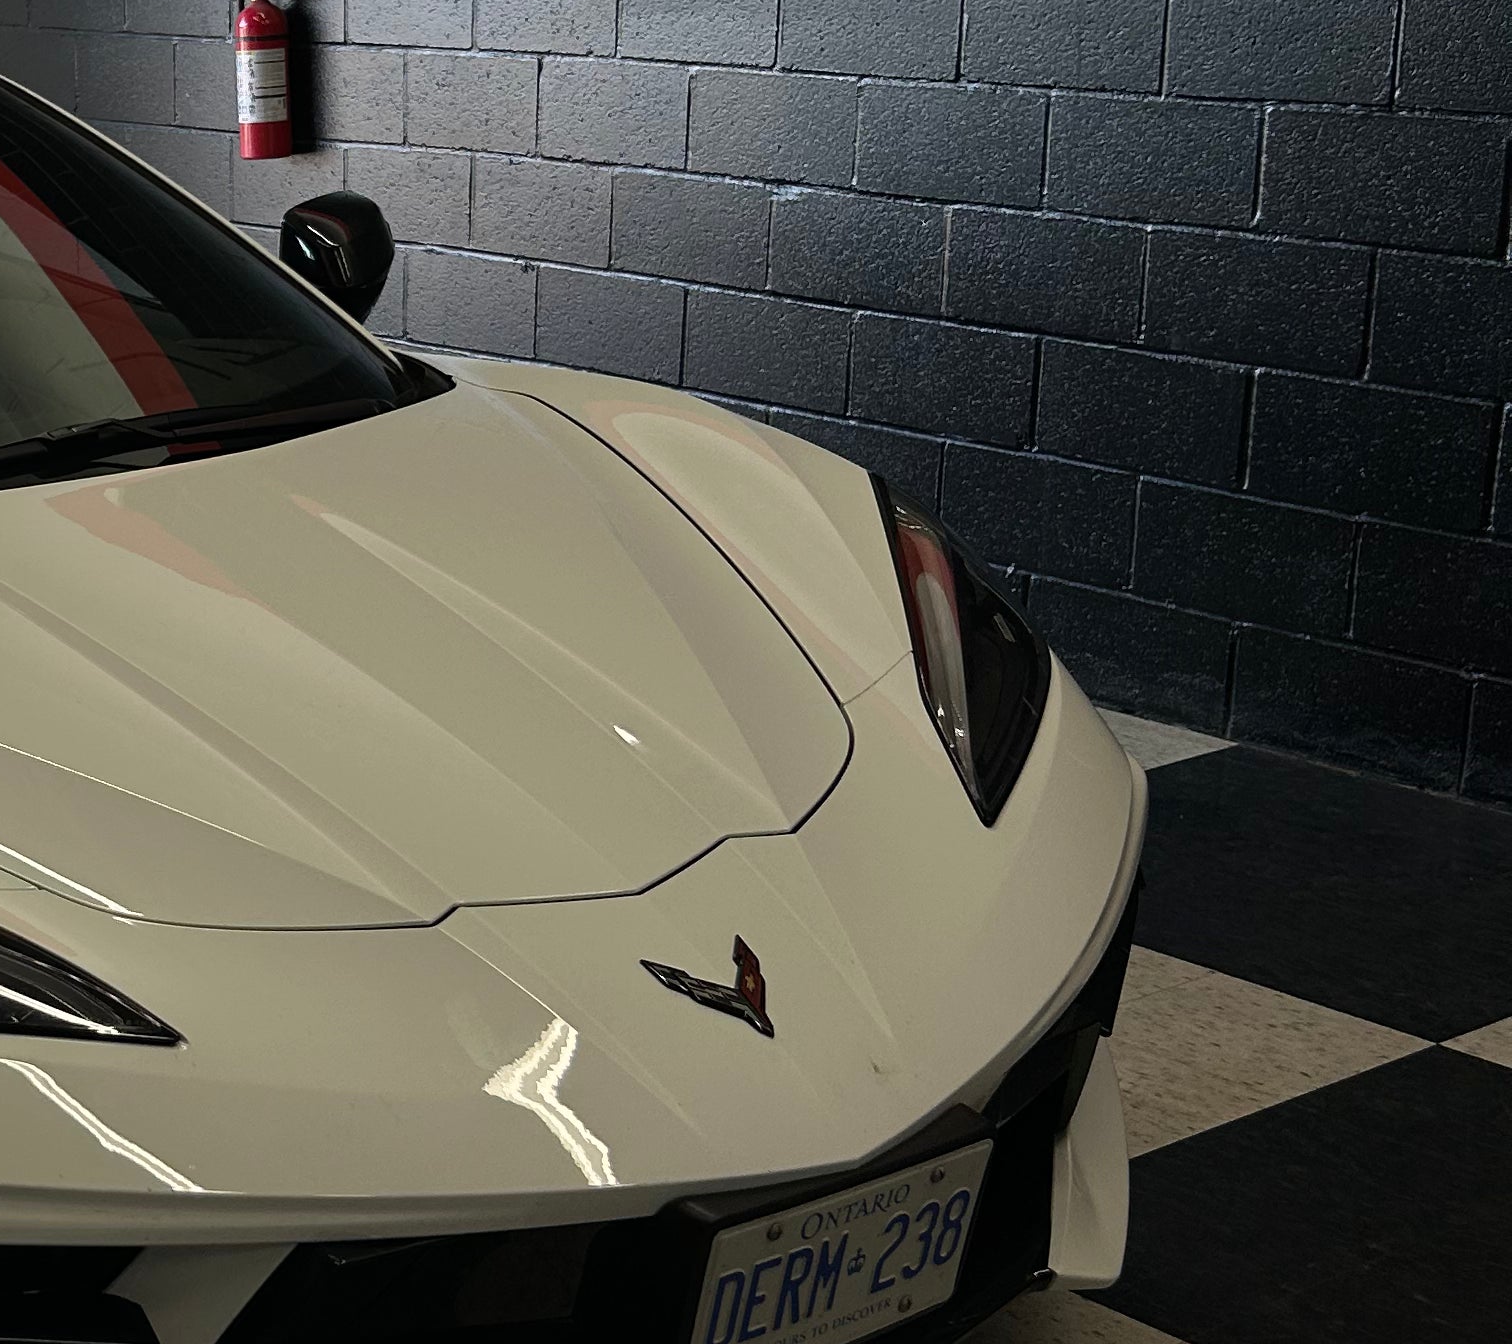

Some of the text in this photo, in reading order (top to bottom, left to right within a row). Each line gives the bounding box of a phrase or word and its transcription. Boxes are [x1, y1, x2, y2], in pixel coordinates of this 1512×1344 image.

[800, 1184, 910, 1241] ONTARIO
[870, 1189, 971, 1294] 238
[812, 1323, 829, 1340] TO
[832, 1299, 892, 1331] DISCOVER
